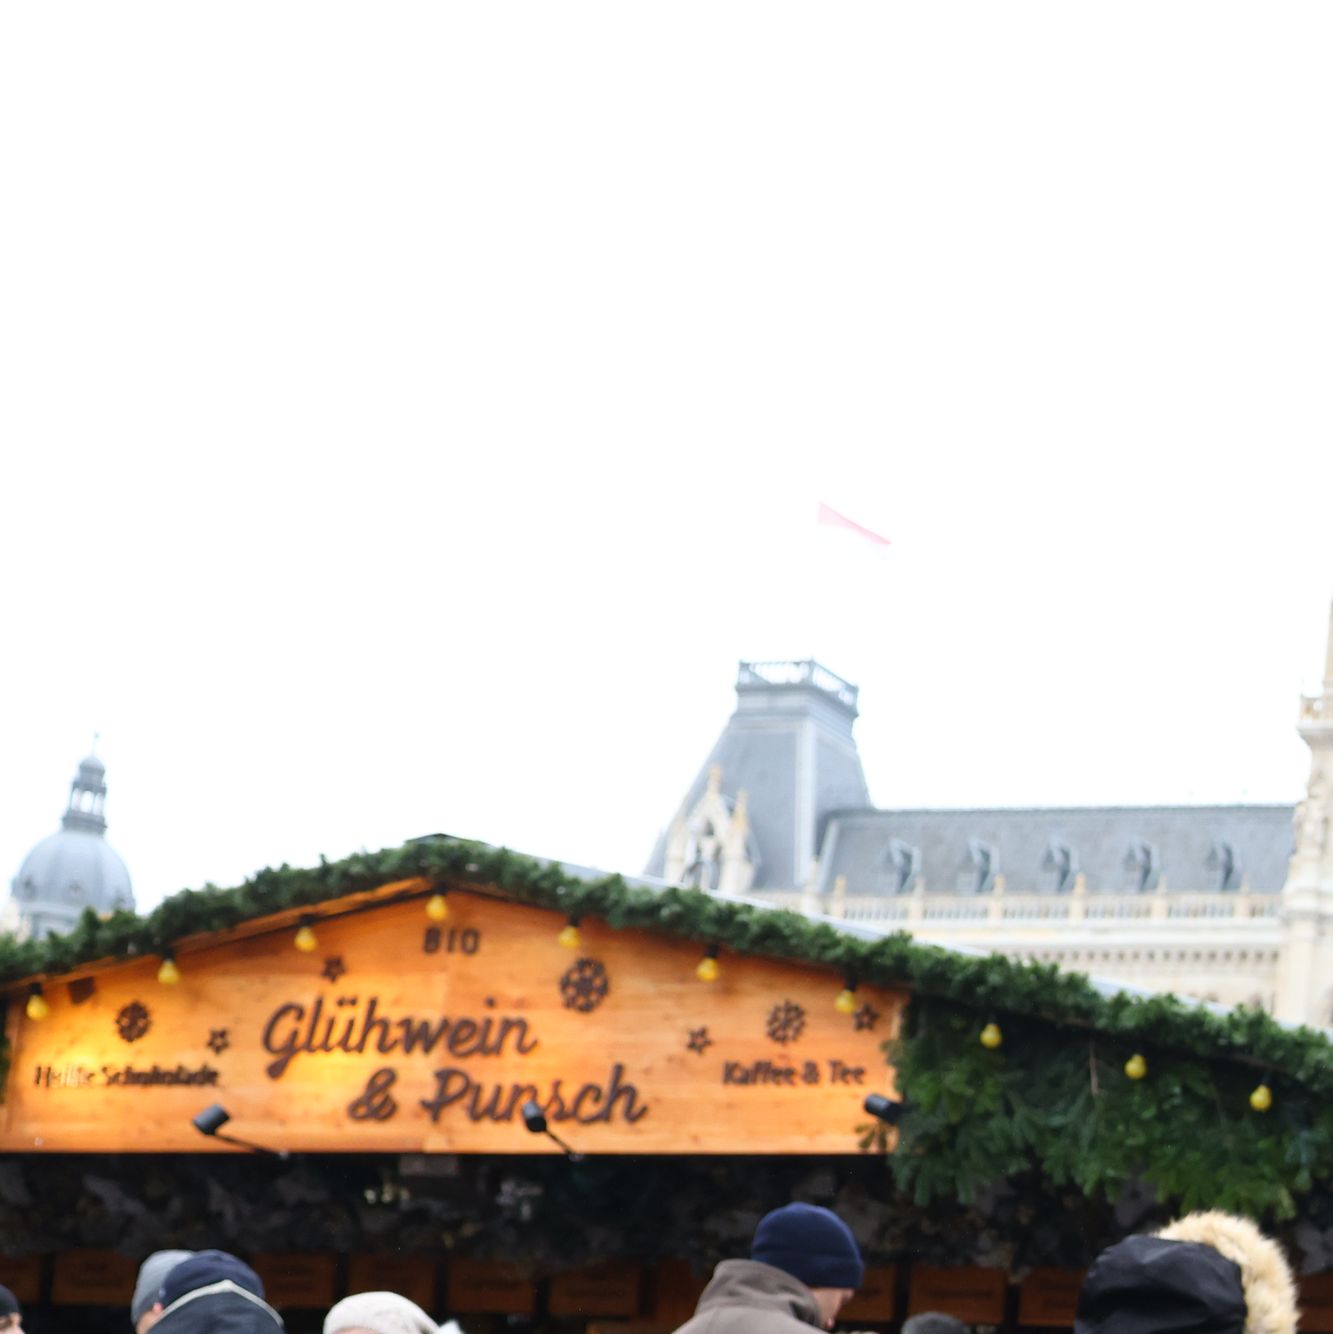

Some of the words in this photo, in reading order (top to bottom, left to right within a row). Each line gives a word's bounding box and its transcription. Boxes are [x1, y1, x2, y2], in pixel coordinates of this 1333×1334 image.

[423, 926, 481, 955] BIO
[261, 994, 538, 1079] Glühwein
[347, 1066, 398, 1121] &
[420, 1062, 649, 1124] Punsch
[722, 1060, 796, 1086] Kaffee
[802, 1060, 820, 1085] &
[829, 1059, 866, 1086] Tee
